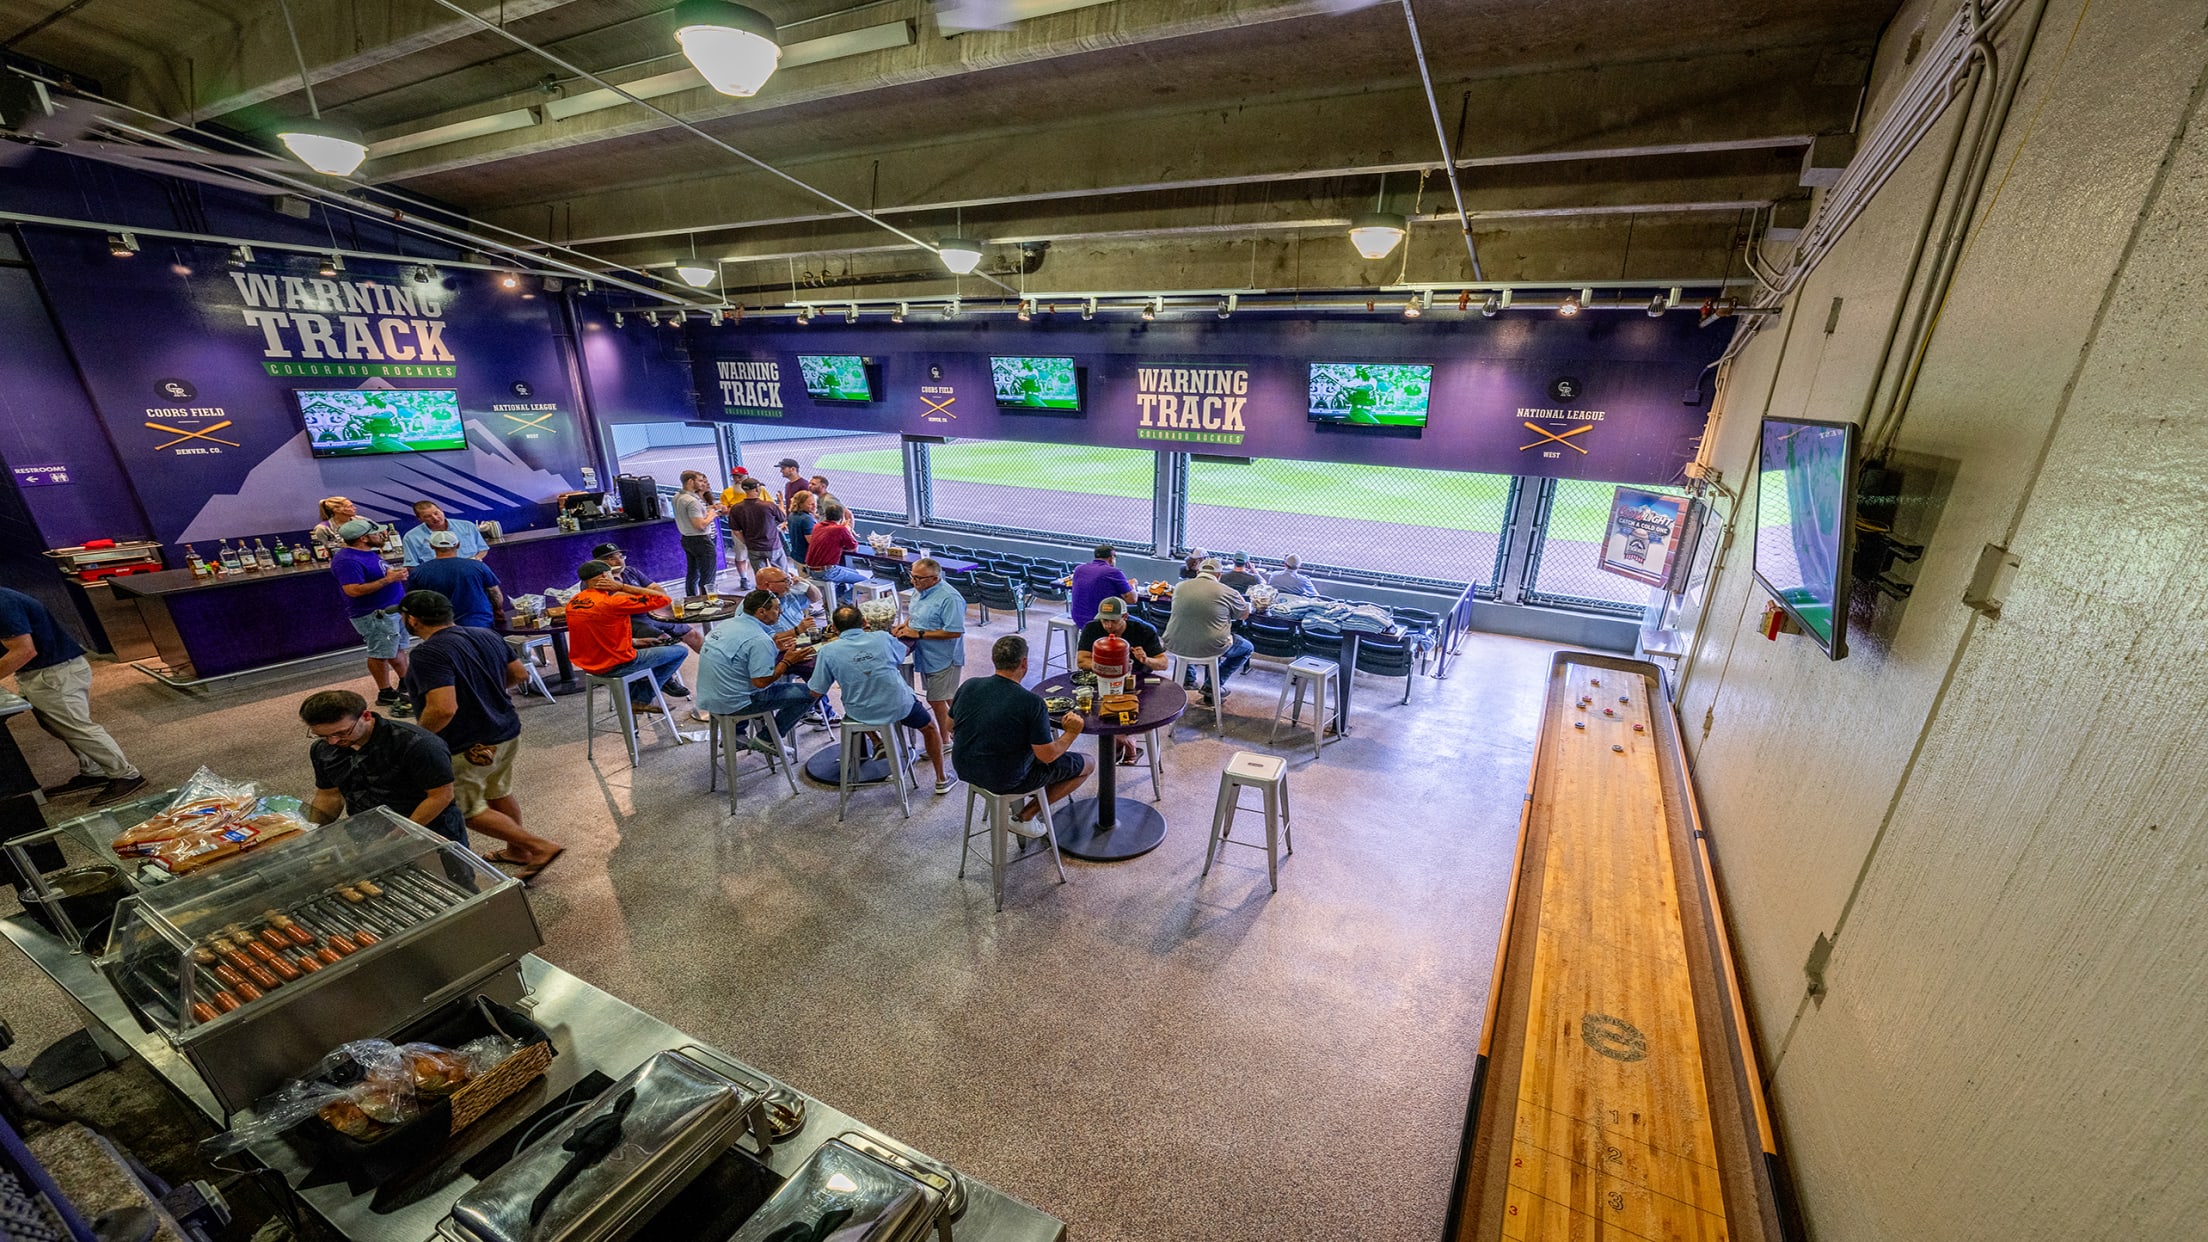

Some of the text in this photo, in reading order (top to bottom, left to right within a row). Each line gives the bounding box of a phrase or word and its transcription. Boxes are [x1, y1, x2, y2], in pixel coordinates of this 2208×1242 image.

[229, 271, 443, 318] WARNING
[242, 309, 455, 362] TRACK
[269, 363, 453, 377] COLORADO ROCKIES
[716, 361, 779, 380] WARNING
[1137, 368, 1248, 395] WARNING
[719, 380, 783, 408] TRACK
[145, 407, 225, 418] COORS FIELD
[493, 403, 557, 412] NATIONAL LEAGUE
[1136, 393, 1246, 431] TRACK
[1516, 408, 1605, 421] NATIONAL LEAGUE
[1140, 430, 1189, 440] COLORADO
[1543, 451, 1561, 459] WEST
[14, 466, 67, 474] RESTROOMS
[1642, 510, 1673, 526] LIGHT
[1618, 517, 1635, 526] CATCH
[1641, 523, 1656, 531] COLD
[1656, 526, 1668, 535] ONE
[1608, 1110, 1620, 1125] 1
[1514, 1158, 1523, 1168] 2
[1607, 1146, 1623, 1165] 2
[1607, 1191, 1624, 1211] 3
[1508, 1205, 1518, 1216] 3
